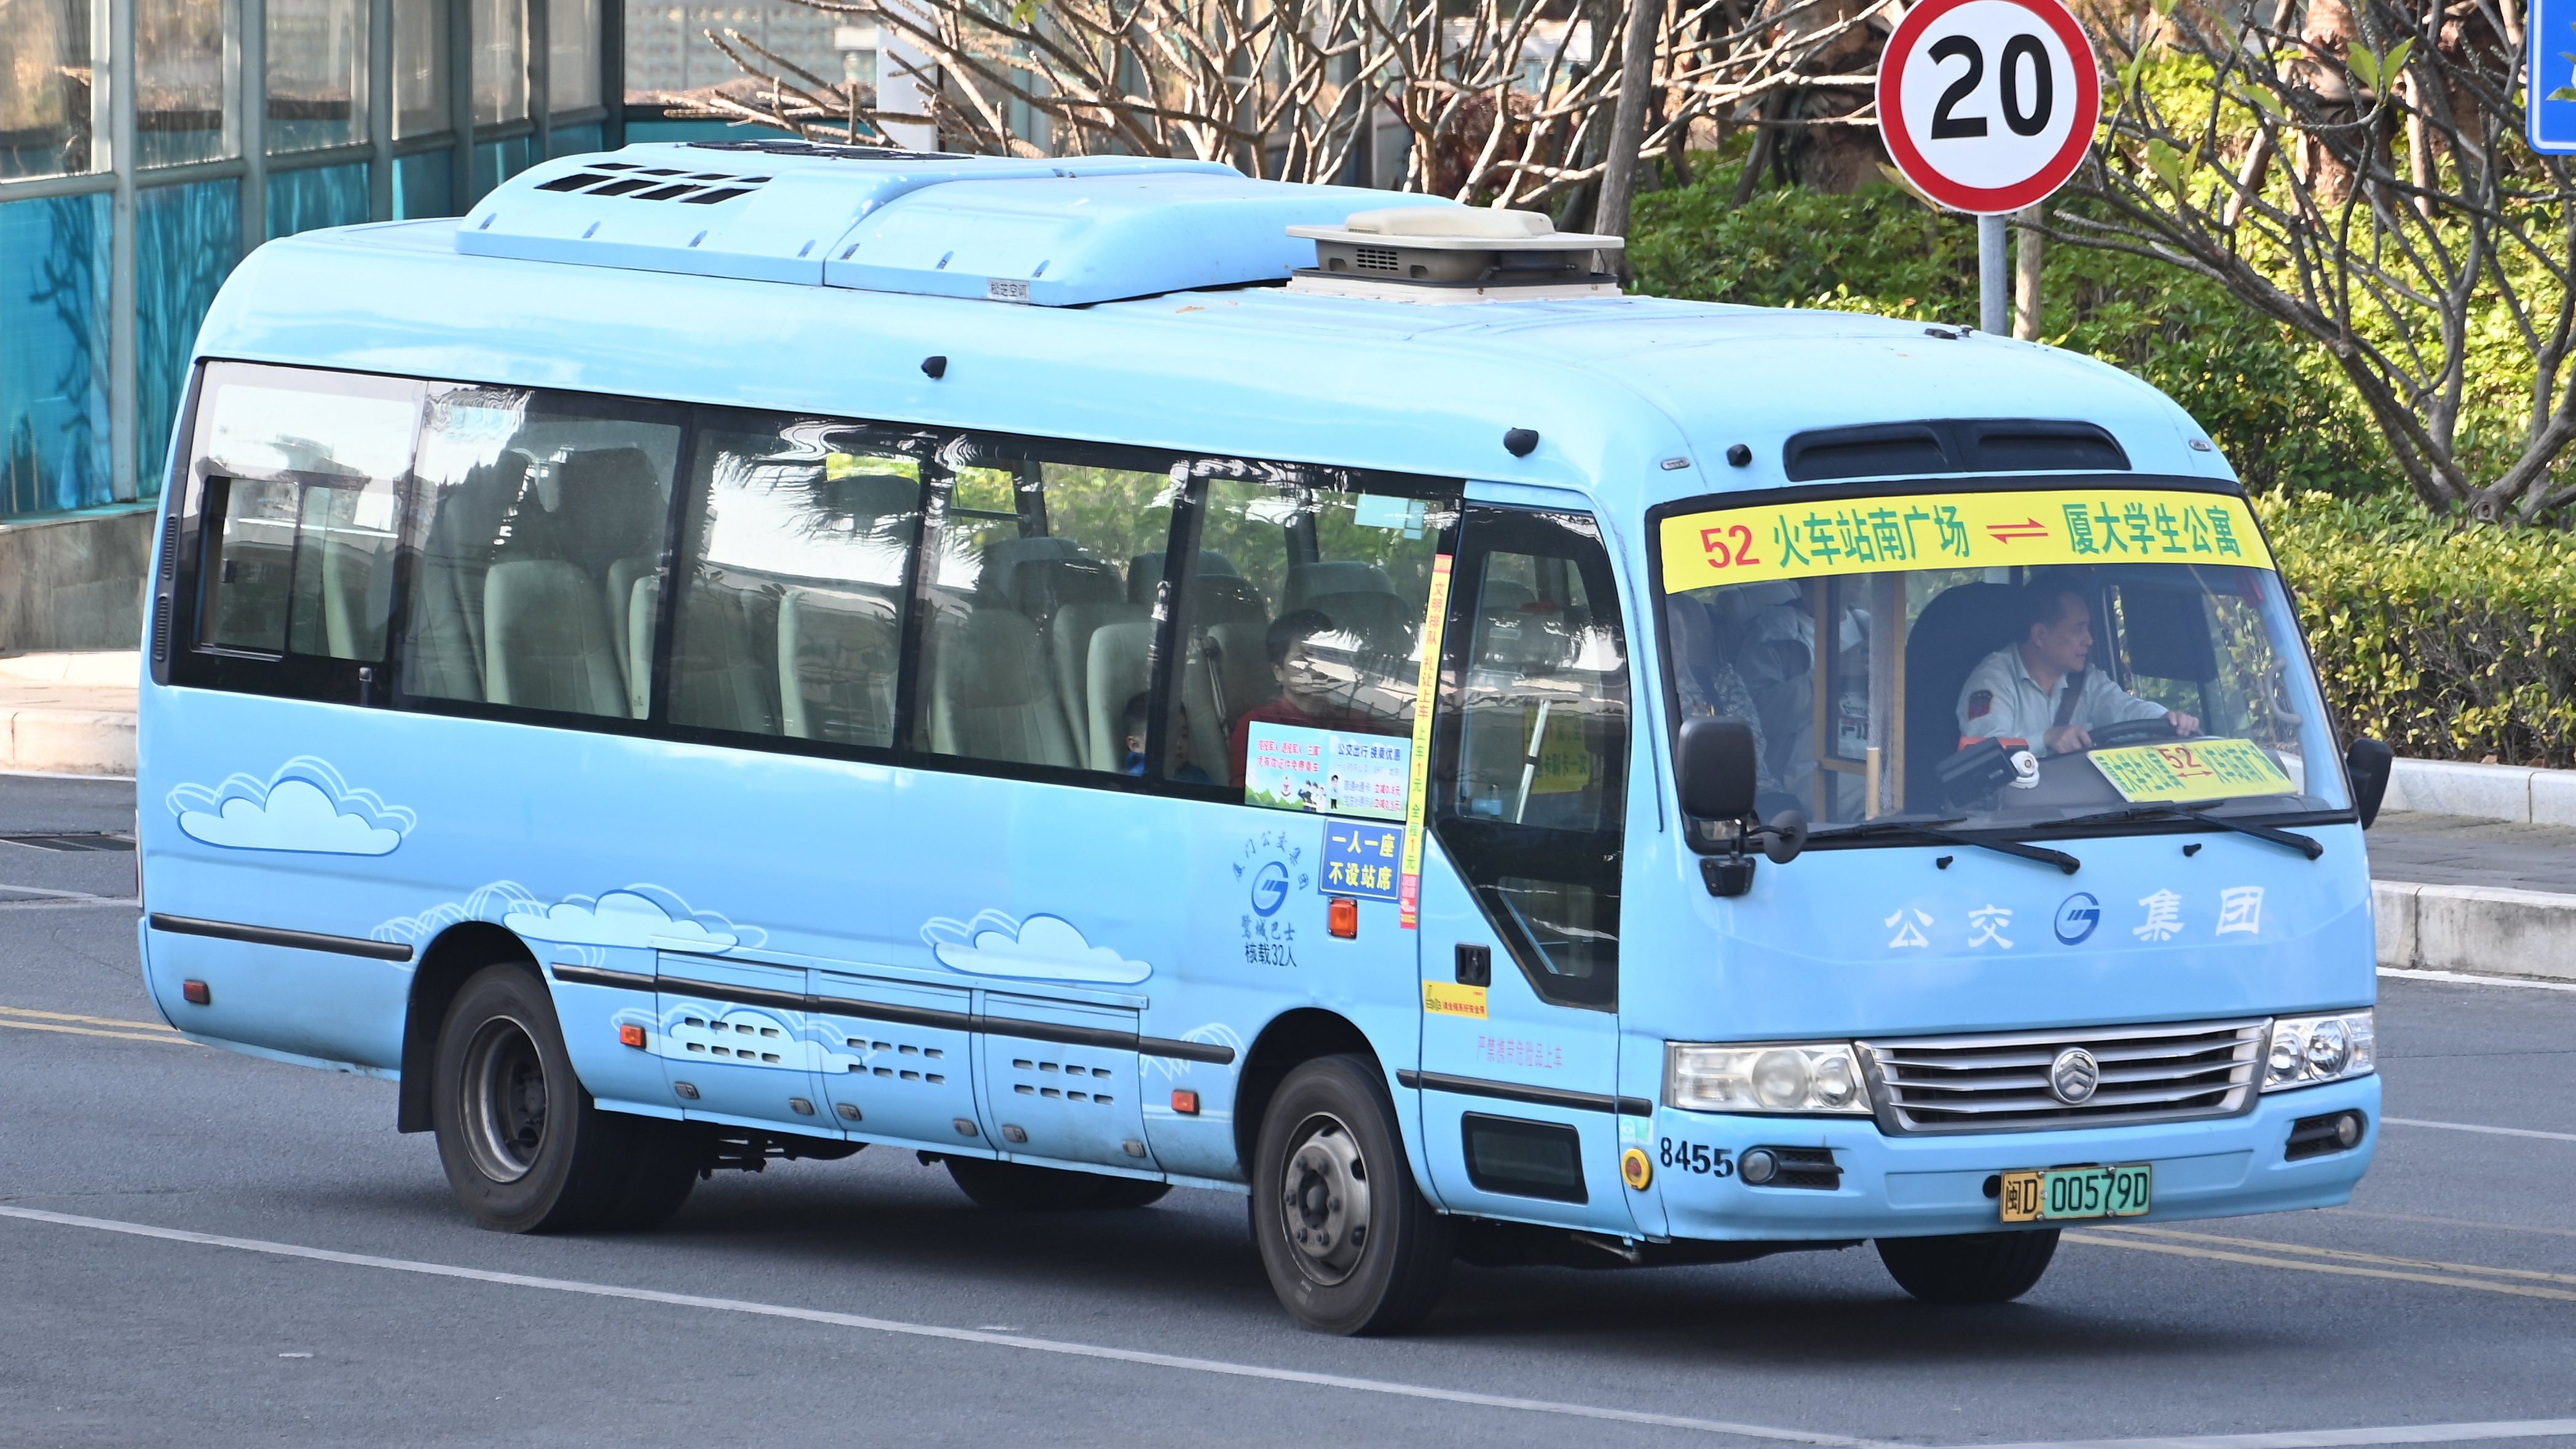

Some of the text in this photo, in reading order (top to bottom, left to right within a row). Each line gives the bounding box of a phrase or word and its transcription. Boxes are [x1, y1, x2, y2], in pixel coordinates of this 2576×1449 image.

[1928, 34, 2053, 140] 20
[1700, 501, 2242, 569] 52 火车站南广场 厦大学生公寓
[1425, 581, 1444, 646] 文明排队
[1417, 657, 1435, 721] 礼让上车
[1337, 743, 1401, 762] 公交出行 换乘优惠
[2158, 746, 2202, 770] 52
[1331, 830, 1396, 858] 一人一座
[1328, 861, 1393, 891] 不设站席
[1884, 886, 2265, 950] 公交 集团
[1244, 942, 1297, 968] 核载32人
[1660, 1137, 1734, 1178] 8455
[2006, 1172, 2148, 1214] 闽D 00579D
